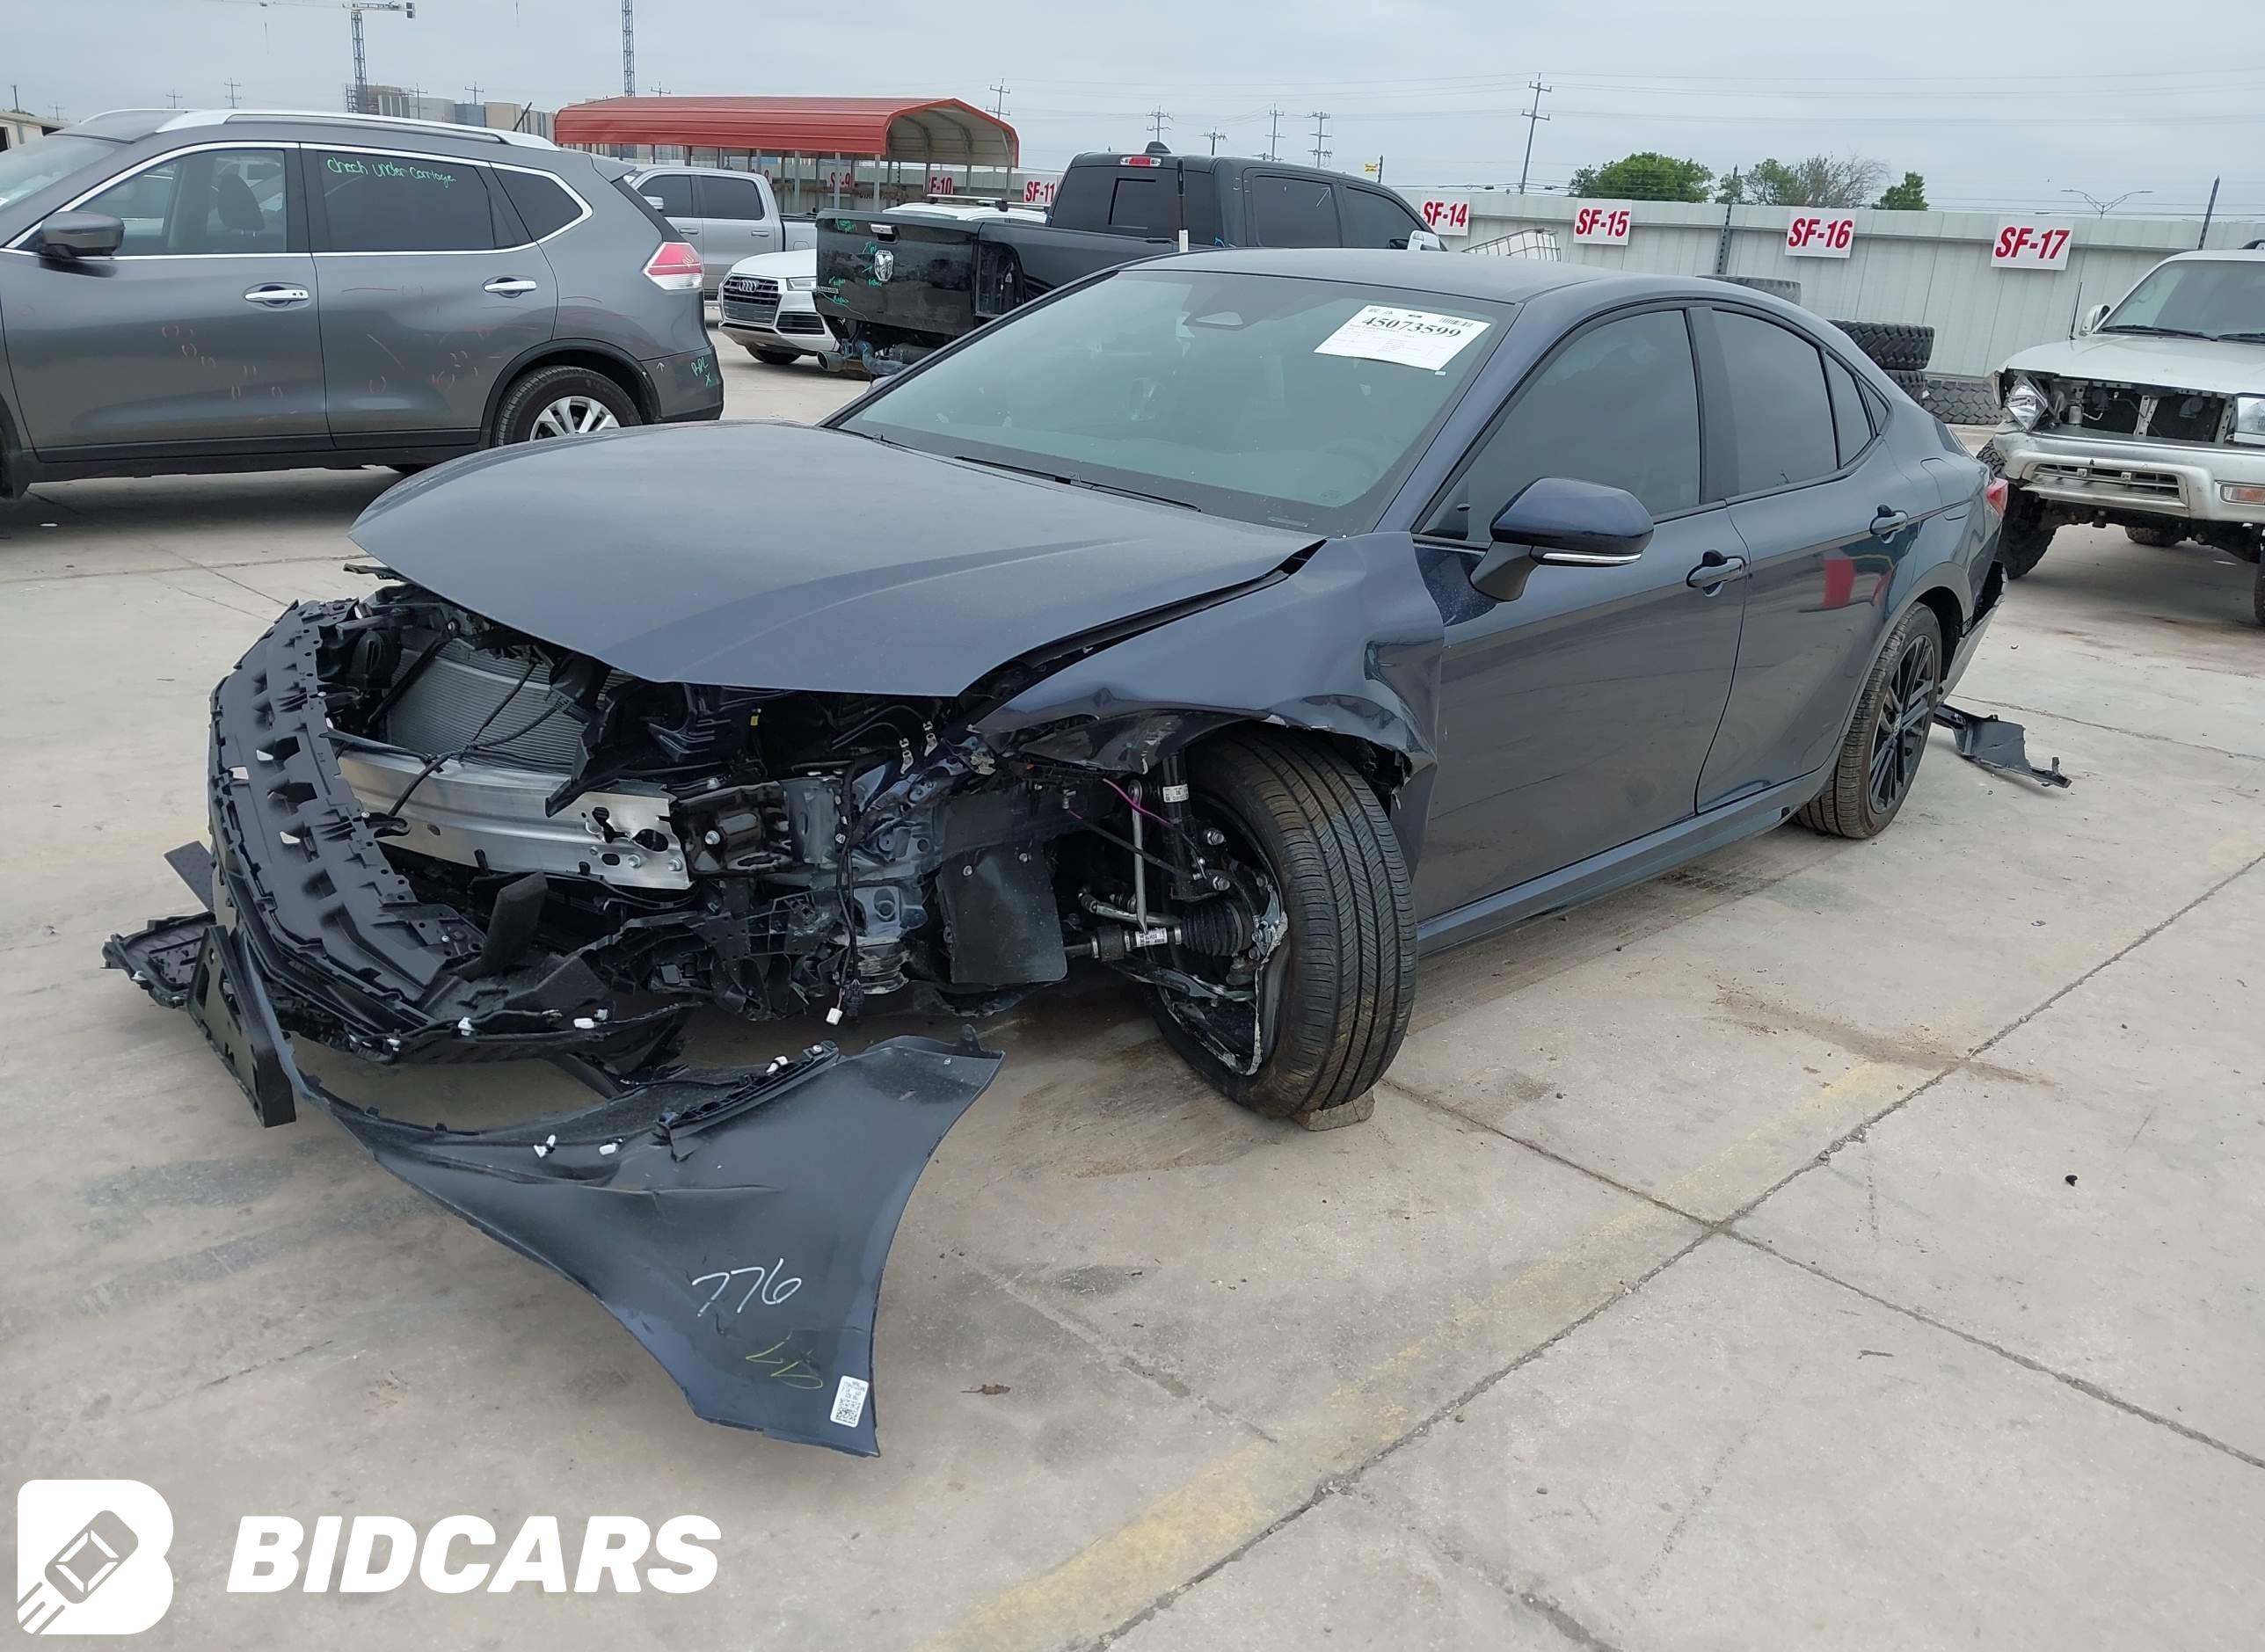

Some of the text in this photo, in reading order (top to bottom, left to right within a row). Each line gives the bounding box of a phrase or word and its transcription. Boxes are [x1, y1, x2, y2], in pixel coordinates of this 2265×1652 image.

[829, 171, 852, 189] S-9
[929, 176, 952, 195] F-10
[1025, 180, 1055, 202] SF-11
[1423, 200, 1468, 229] SF-14
[1576, 207, 1630, 237] SF-15
[1788, 217, 1854, 249] SF-16
[1994, 226, 2070, 259] SF-17
[1362, 317, 1461, 338] 45073599
[691, 1257, 802, 1318] 776
